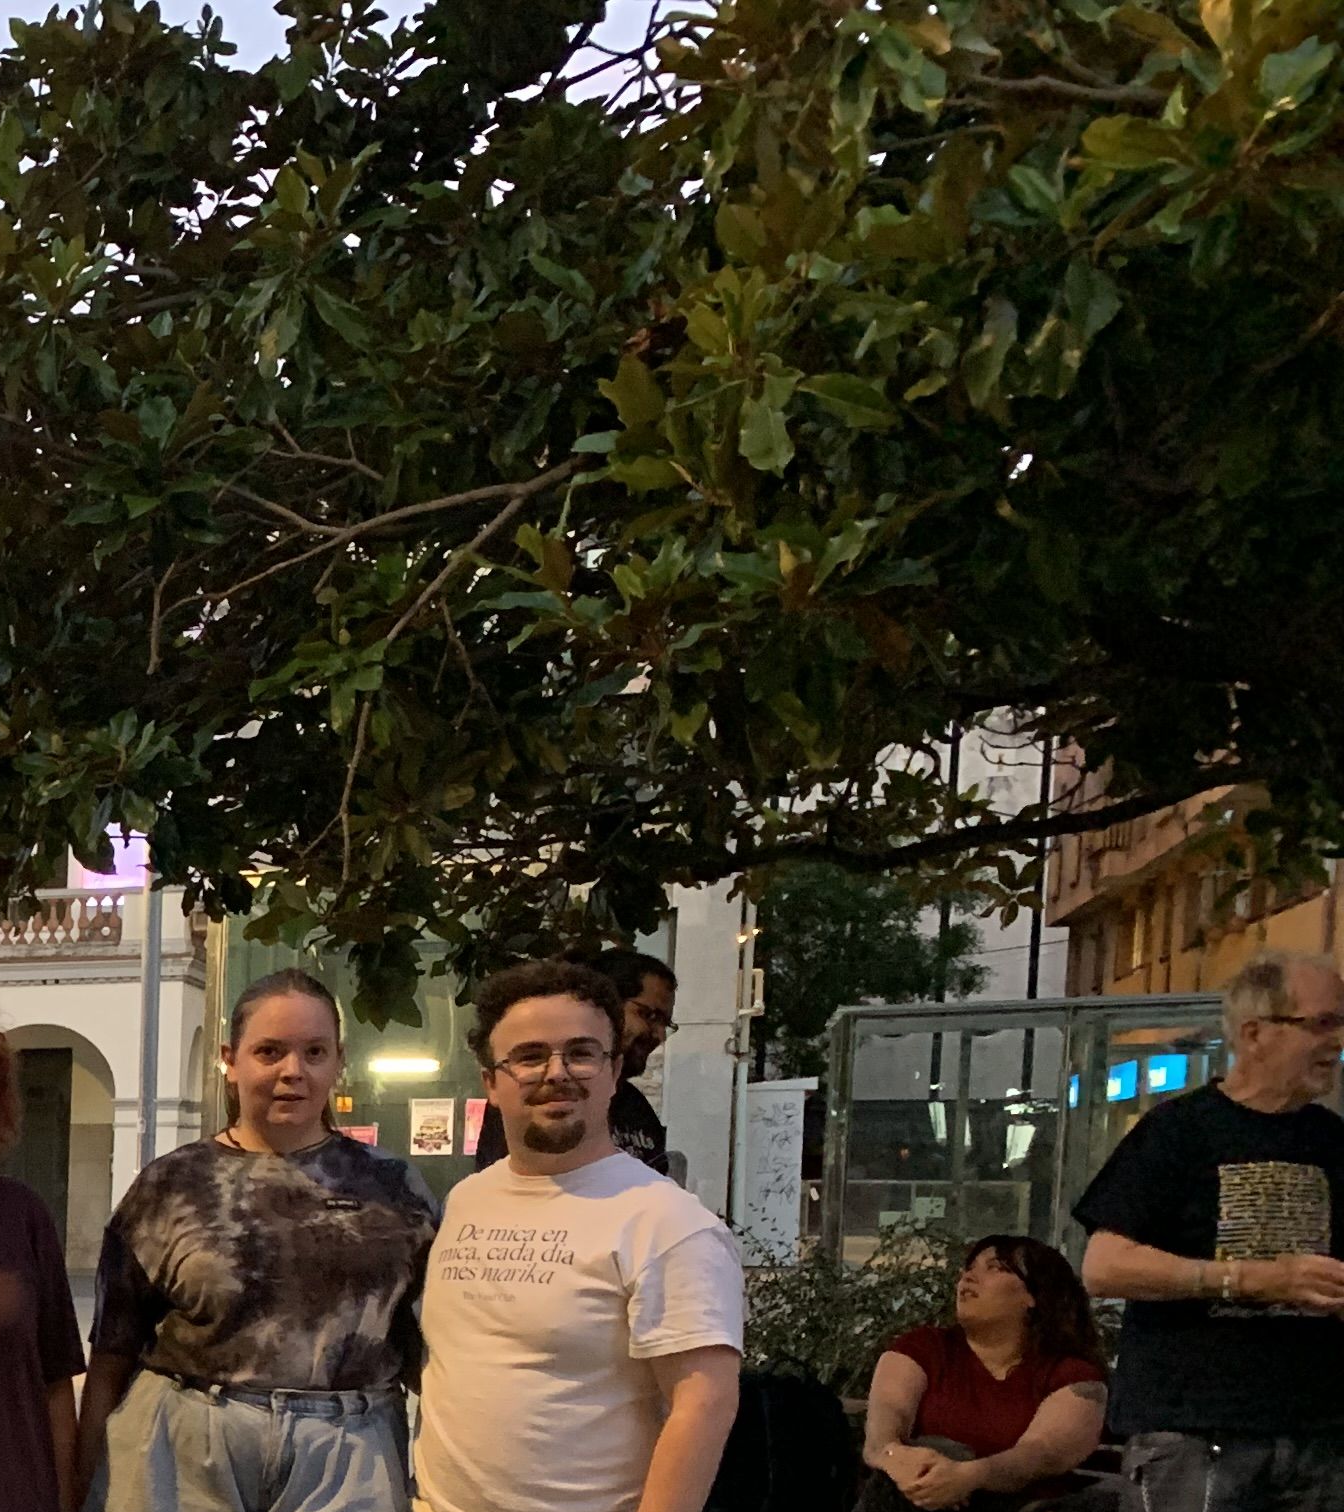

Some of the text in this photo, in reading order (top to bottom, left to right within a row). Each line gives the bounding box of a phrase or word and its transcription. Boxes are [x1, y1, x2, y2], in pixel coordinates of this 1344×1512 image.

[456, 1223, 568, 1242] De mica en
[487, 1242, 535, 1262] cada
[480, 1261, 556, 1285] marika
